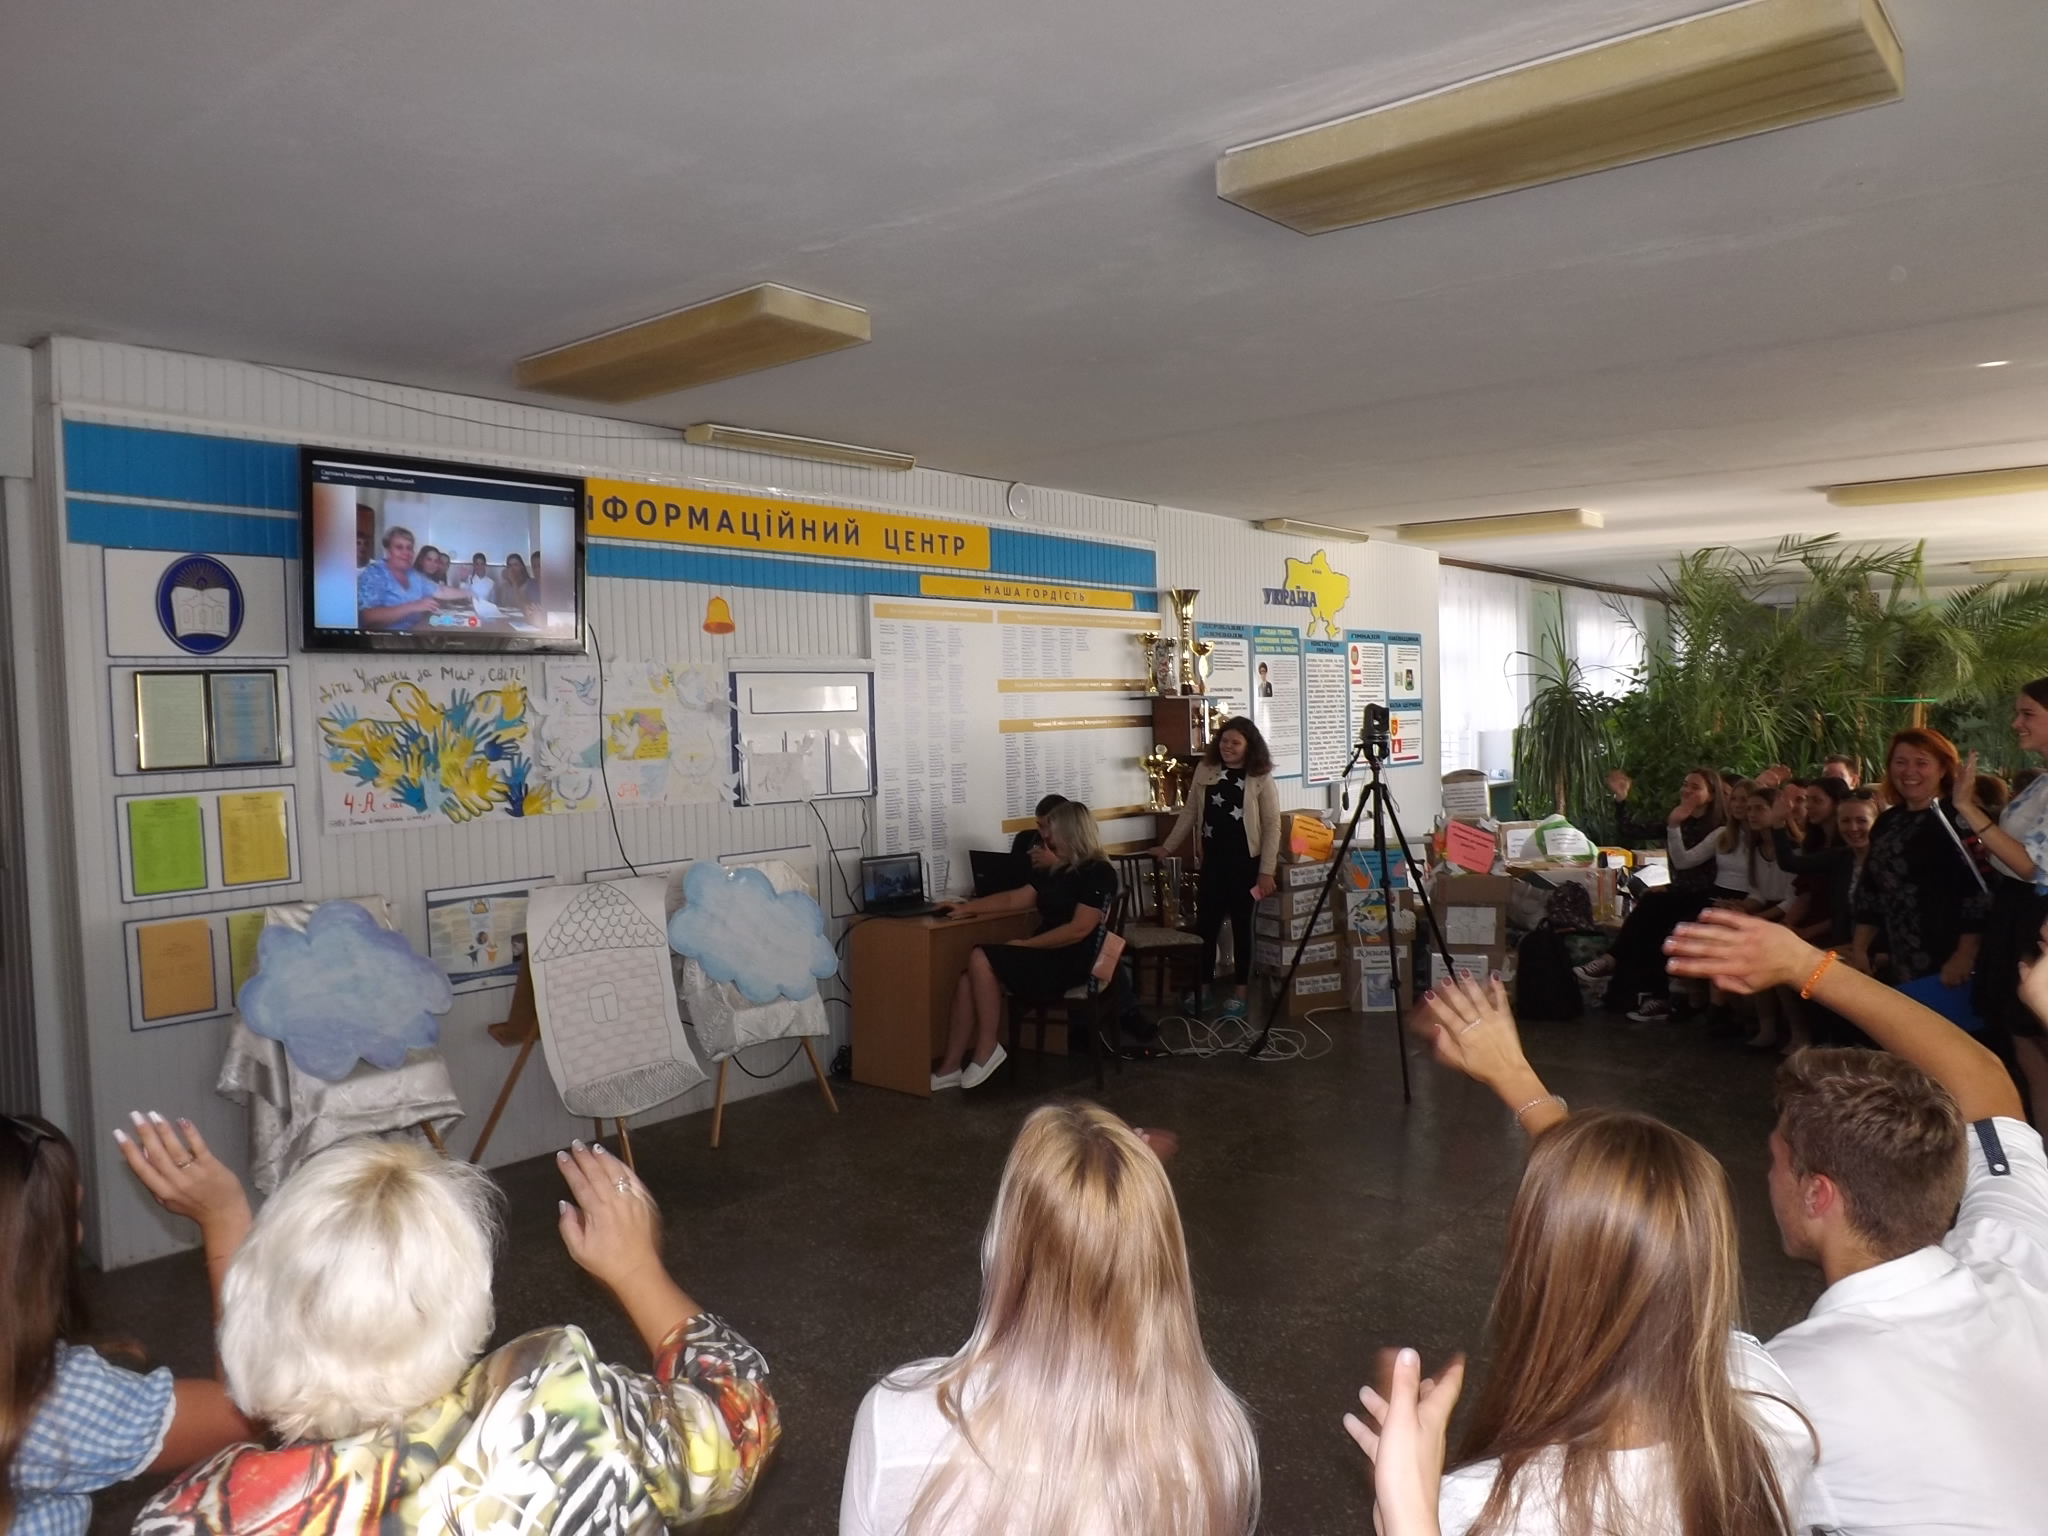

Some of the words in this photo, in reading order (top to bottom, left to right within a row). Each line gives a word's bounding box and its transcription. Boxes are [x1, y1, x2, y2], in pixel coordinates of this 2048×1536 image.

[884, 528, 965, 556] ЦЕНТР
[984, 585, 1021, 597] НАША
[1026, 587, 1085, 601] ГОРДІСТЬ
[1262, 585, 1318, 607] УКРАЇНА
